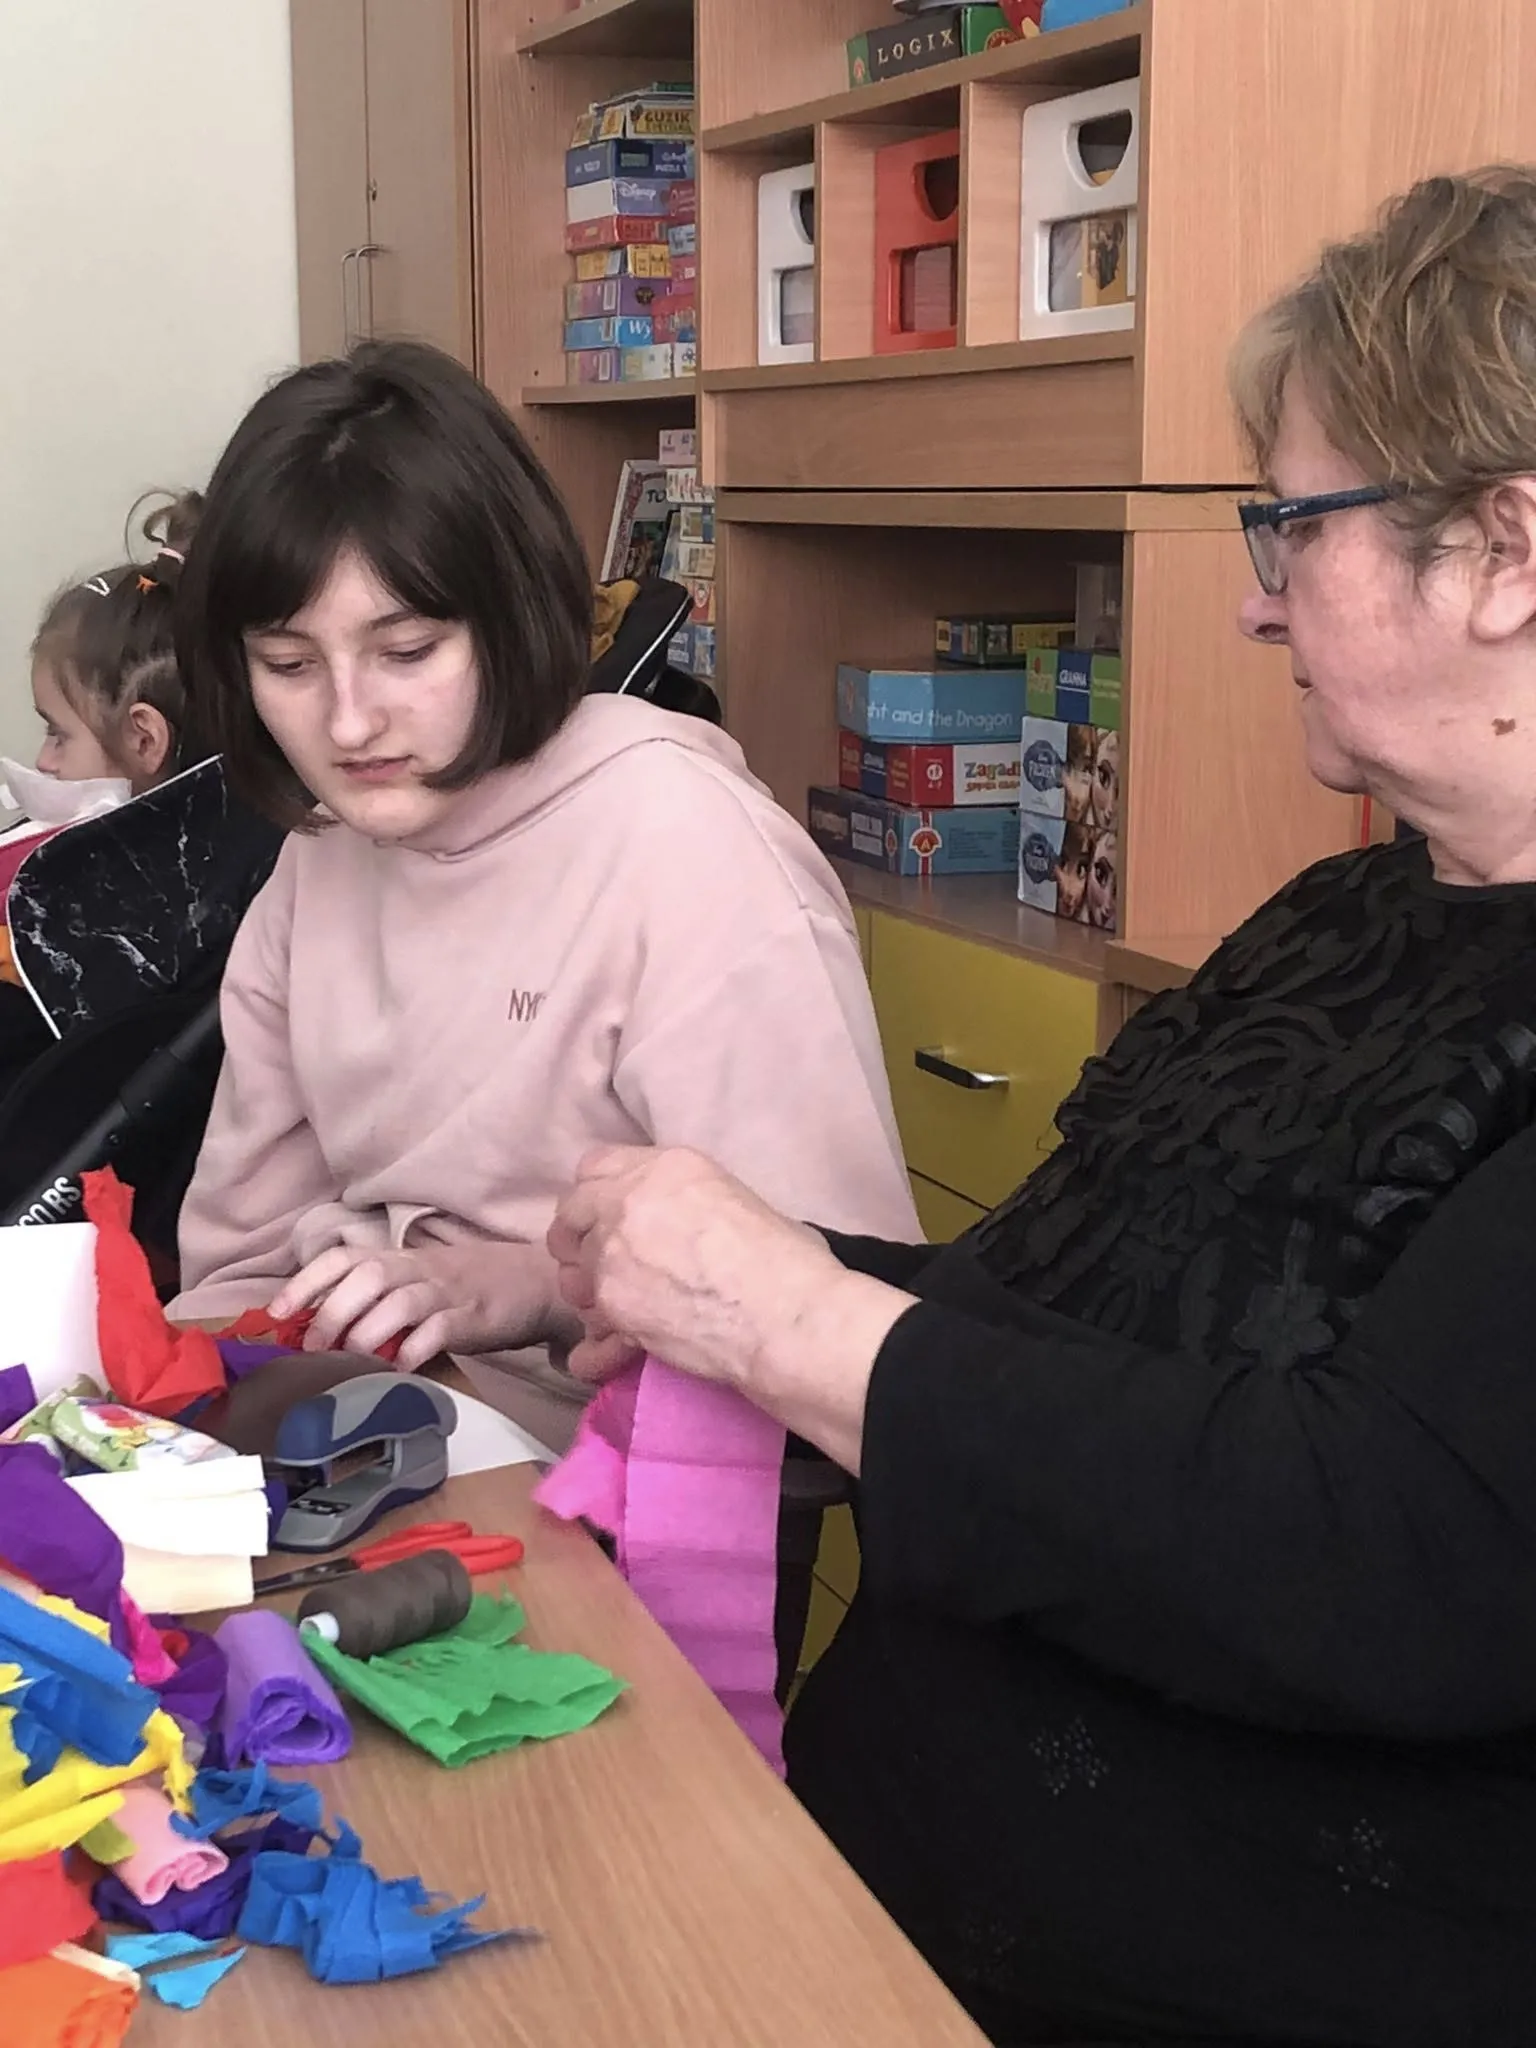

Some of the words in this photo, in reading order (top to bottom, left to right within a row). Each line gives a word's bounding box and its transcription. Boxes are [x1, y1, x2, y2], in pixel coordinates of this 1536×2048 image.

[877, 28, 954, 65] LOGIX
[892, 707, 924, 726] and
[928, 709, 953, 728] the
[956, 710, 1012, 732] Dragon
